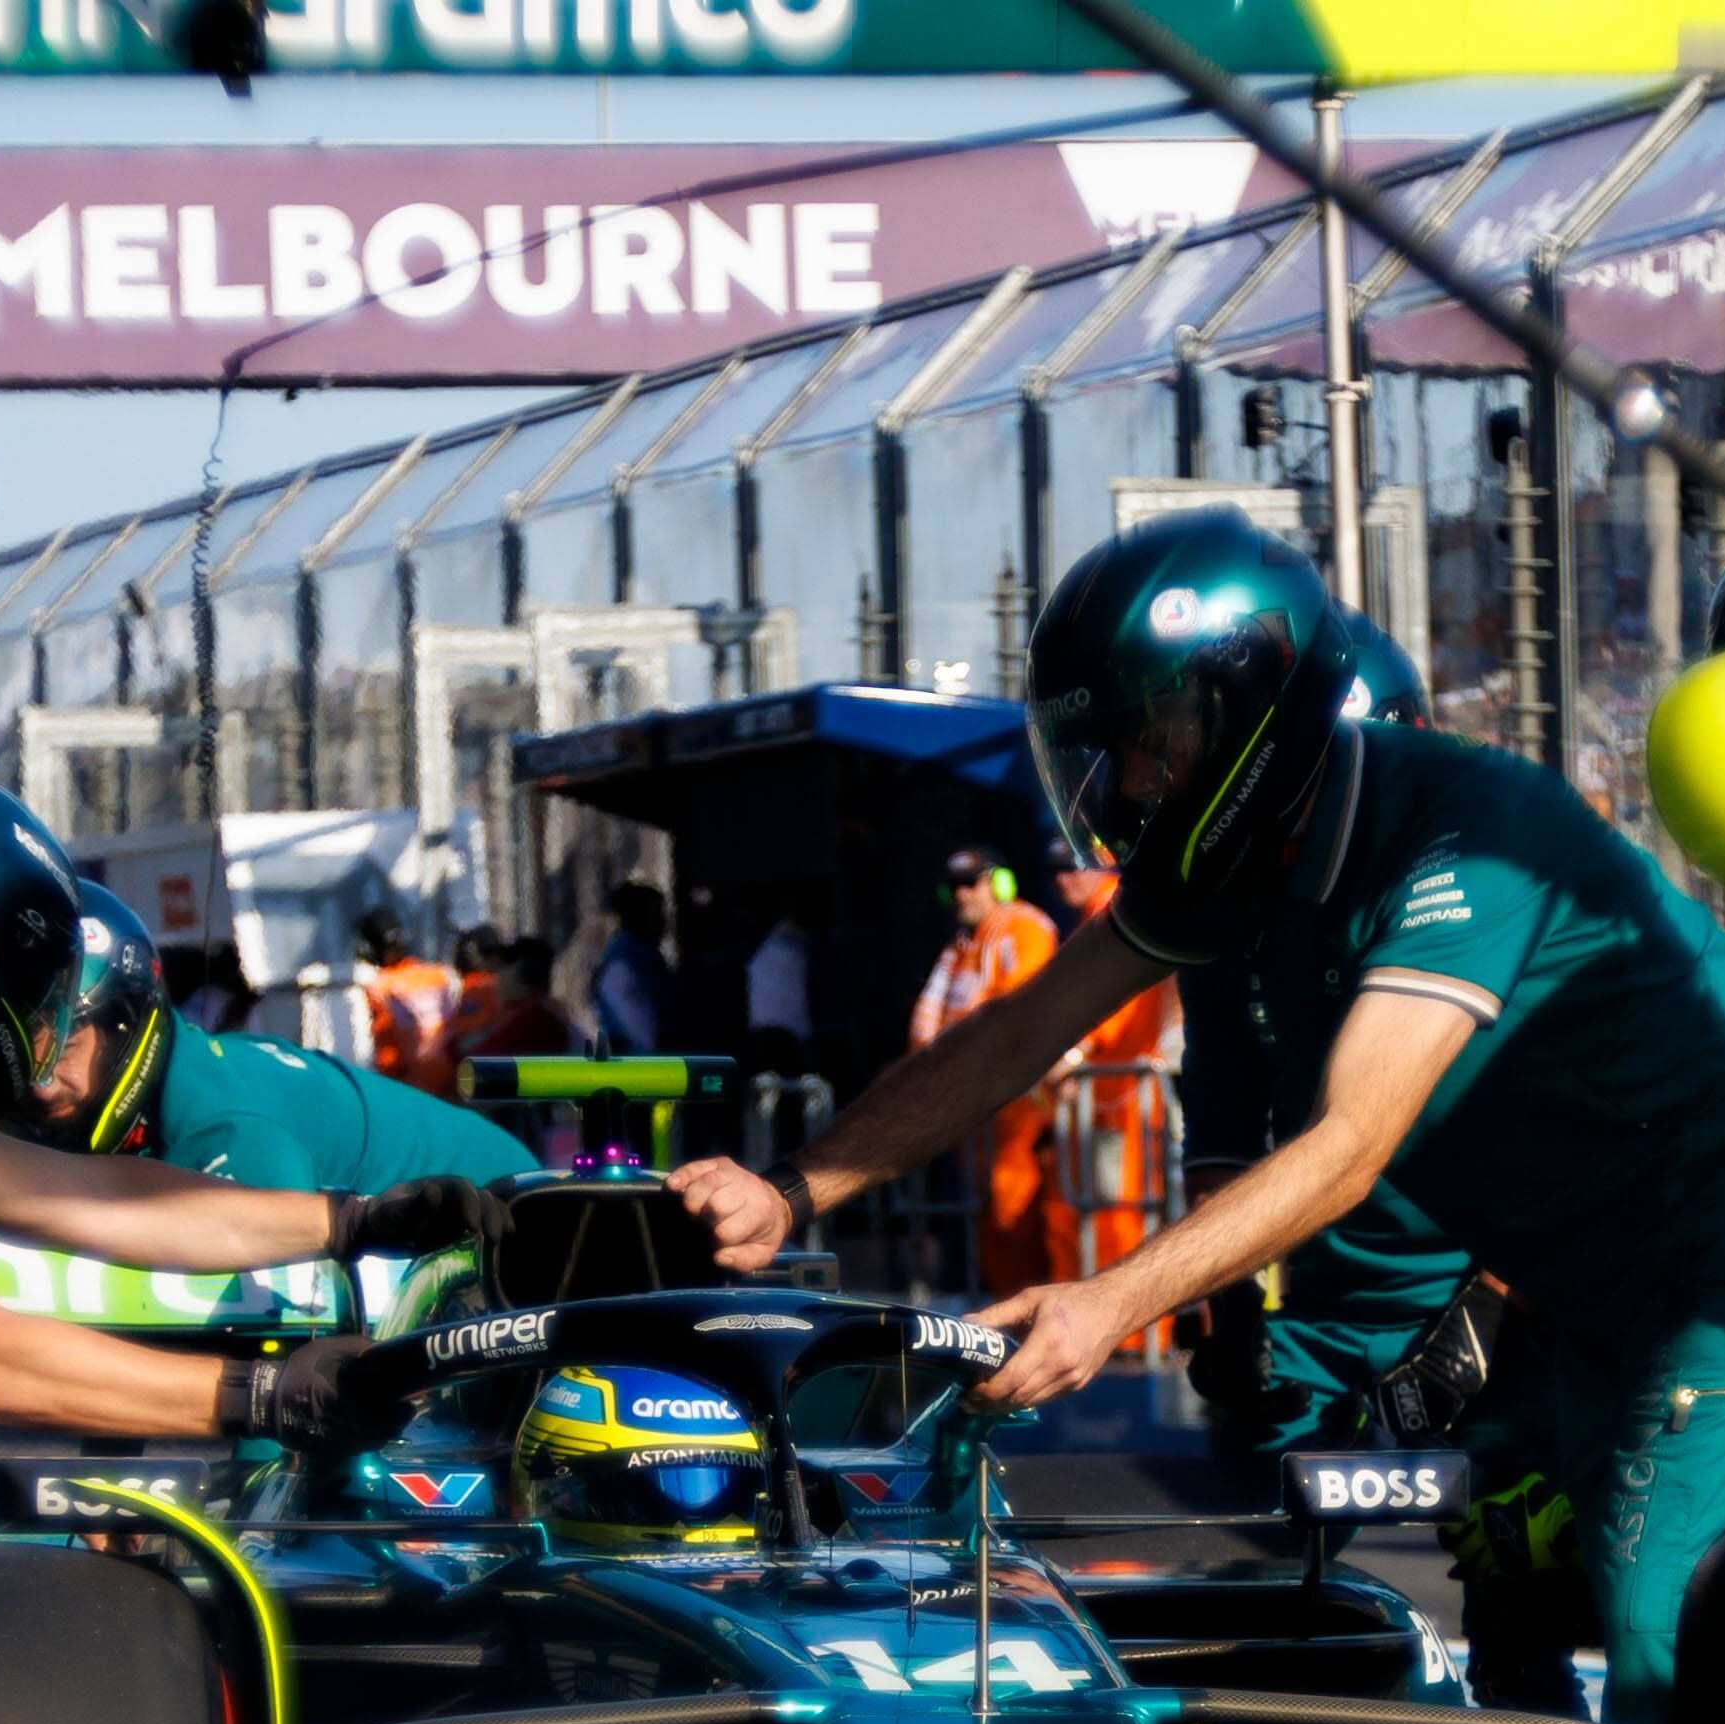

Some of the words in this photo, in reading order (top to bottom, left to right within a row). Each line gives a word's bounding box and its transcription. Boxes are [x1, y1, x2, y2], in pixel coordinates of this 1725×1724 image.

[1200, 804, 1241, 853] ASTON
[1235, 739, 1277, 804] MARTIN
[1399, 907, 1473, 929] AVATRADE
[482, 1341, 549, 1360] NETWORKS
[1398, 1381, 1424, 1431] OMP
[628, 1449, 694, 1469] ASTON
[699, 1450, 765, 1470] MARTIN
[1317, 1468, 1441, 1509] BOSS
[807, 1640, 1091, 1693] 14
